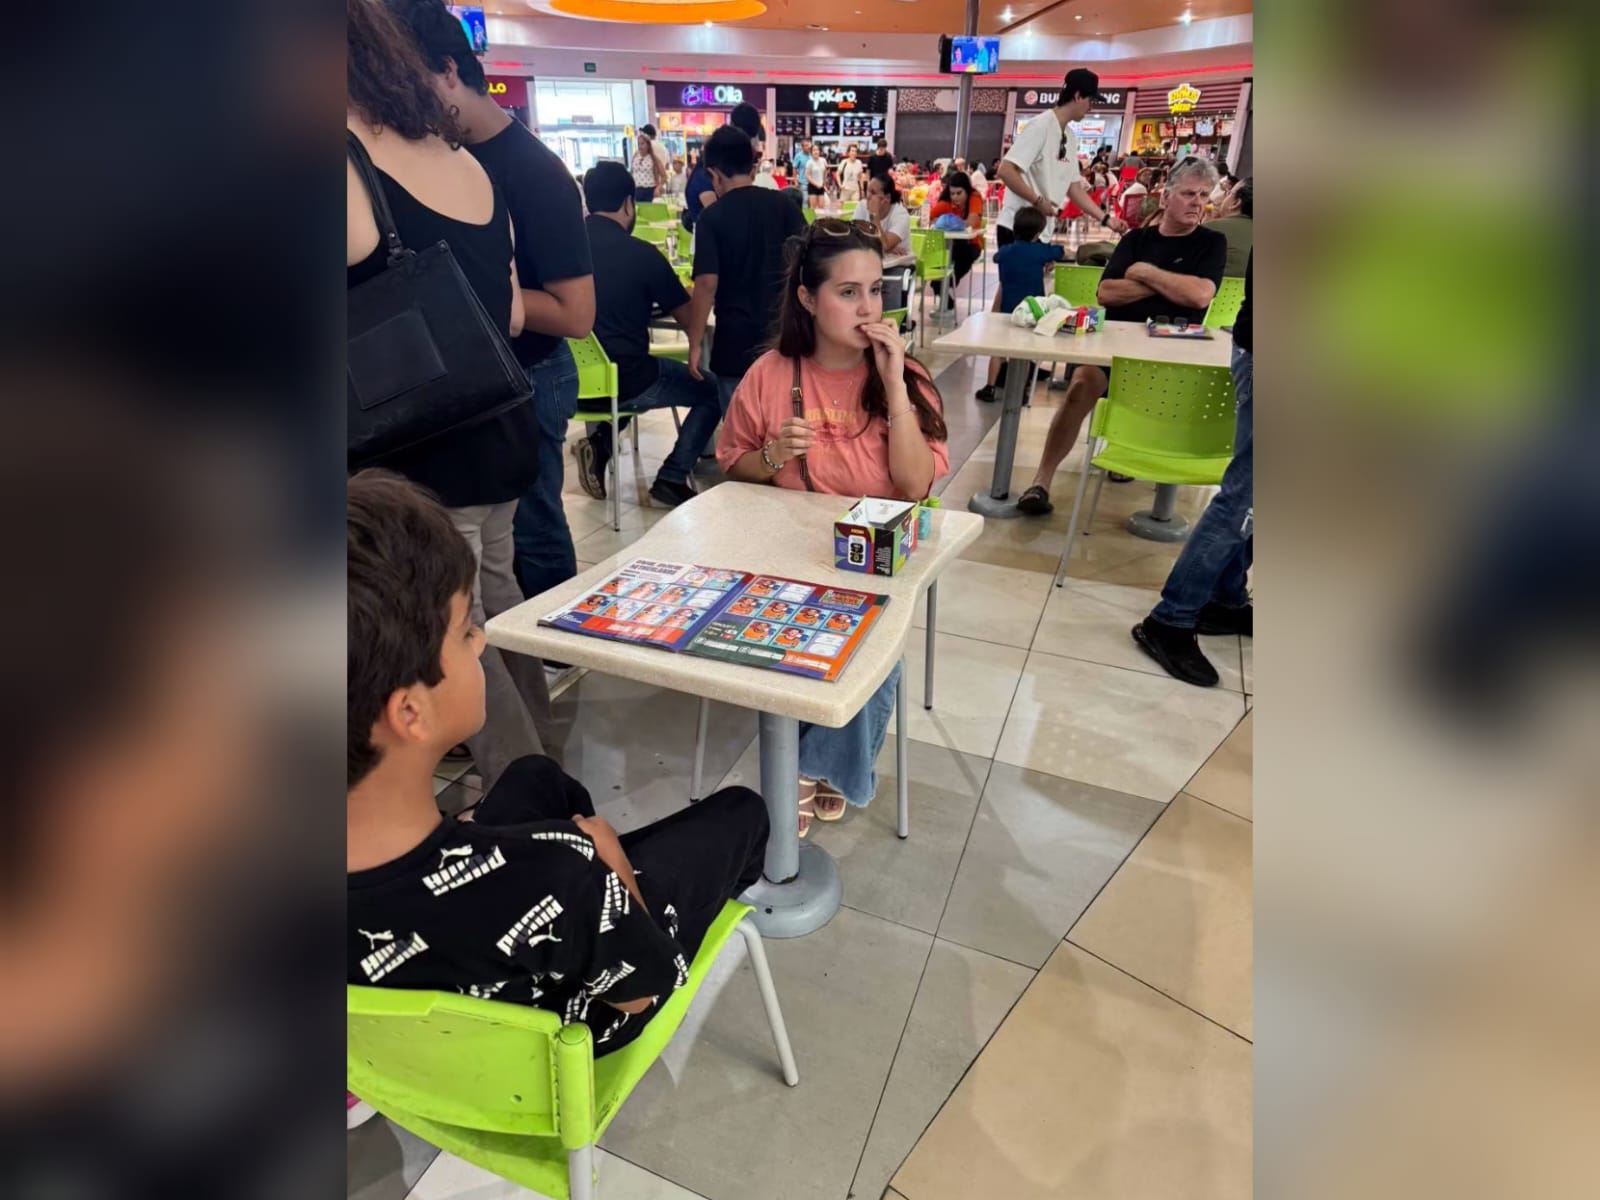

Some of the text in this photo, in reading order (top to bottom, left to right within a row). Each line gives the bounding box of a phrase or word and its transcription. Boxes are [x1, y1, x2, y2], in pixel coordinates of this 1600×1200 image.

[488, 81, 507, 94] LO
[421, 845, 507, 897] PUMA
[495, 894, 565, 957] PUMA
[359, 931, 430, 983] PUMA
